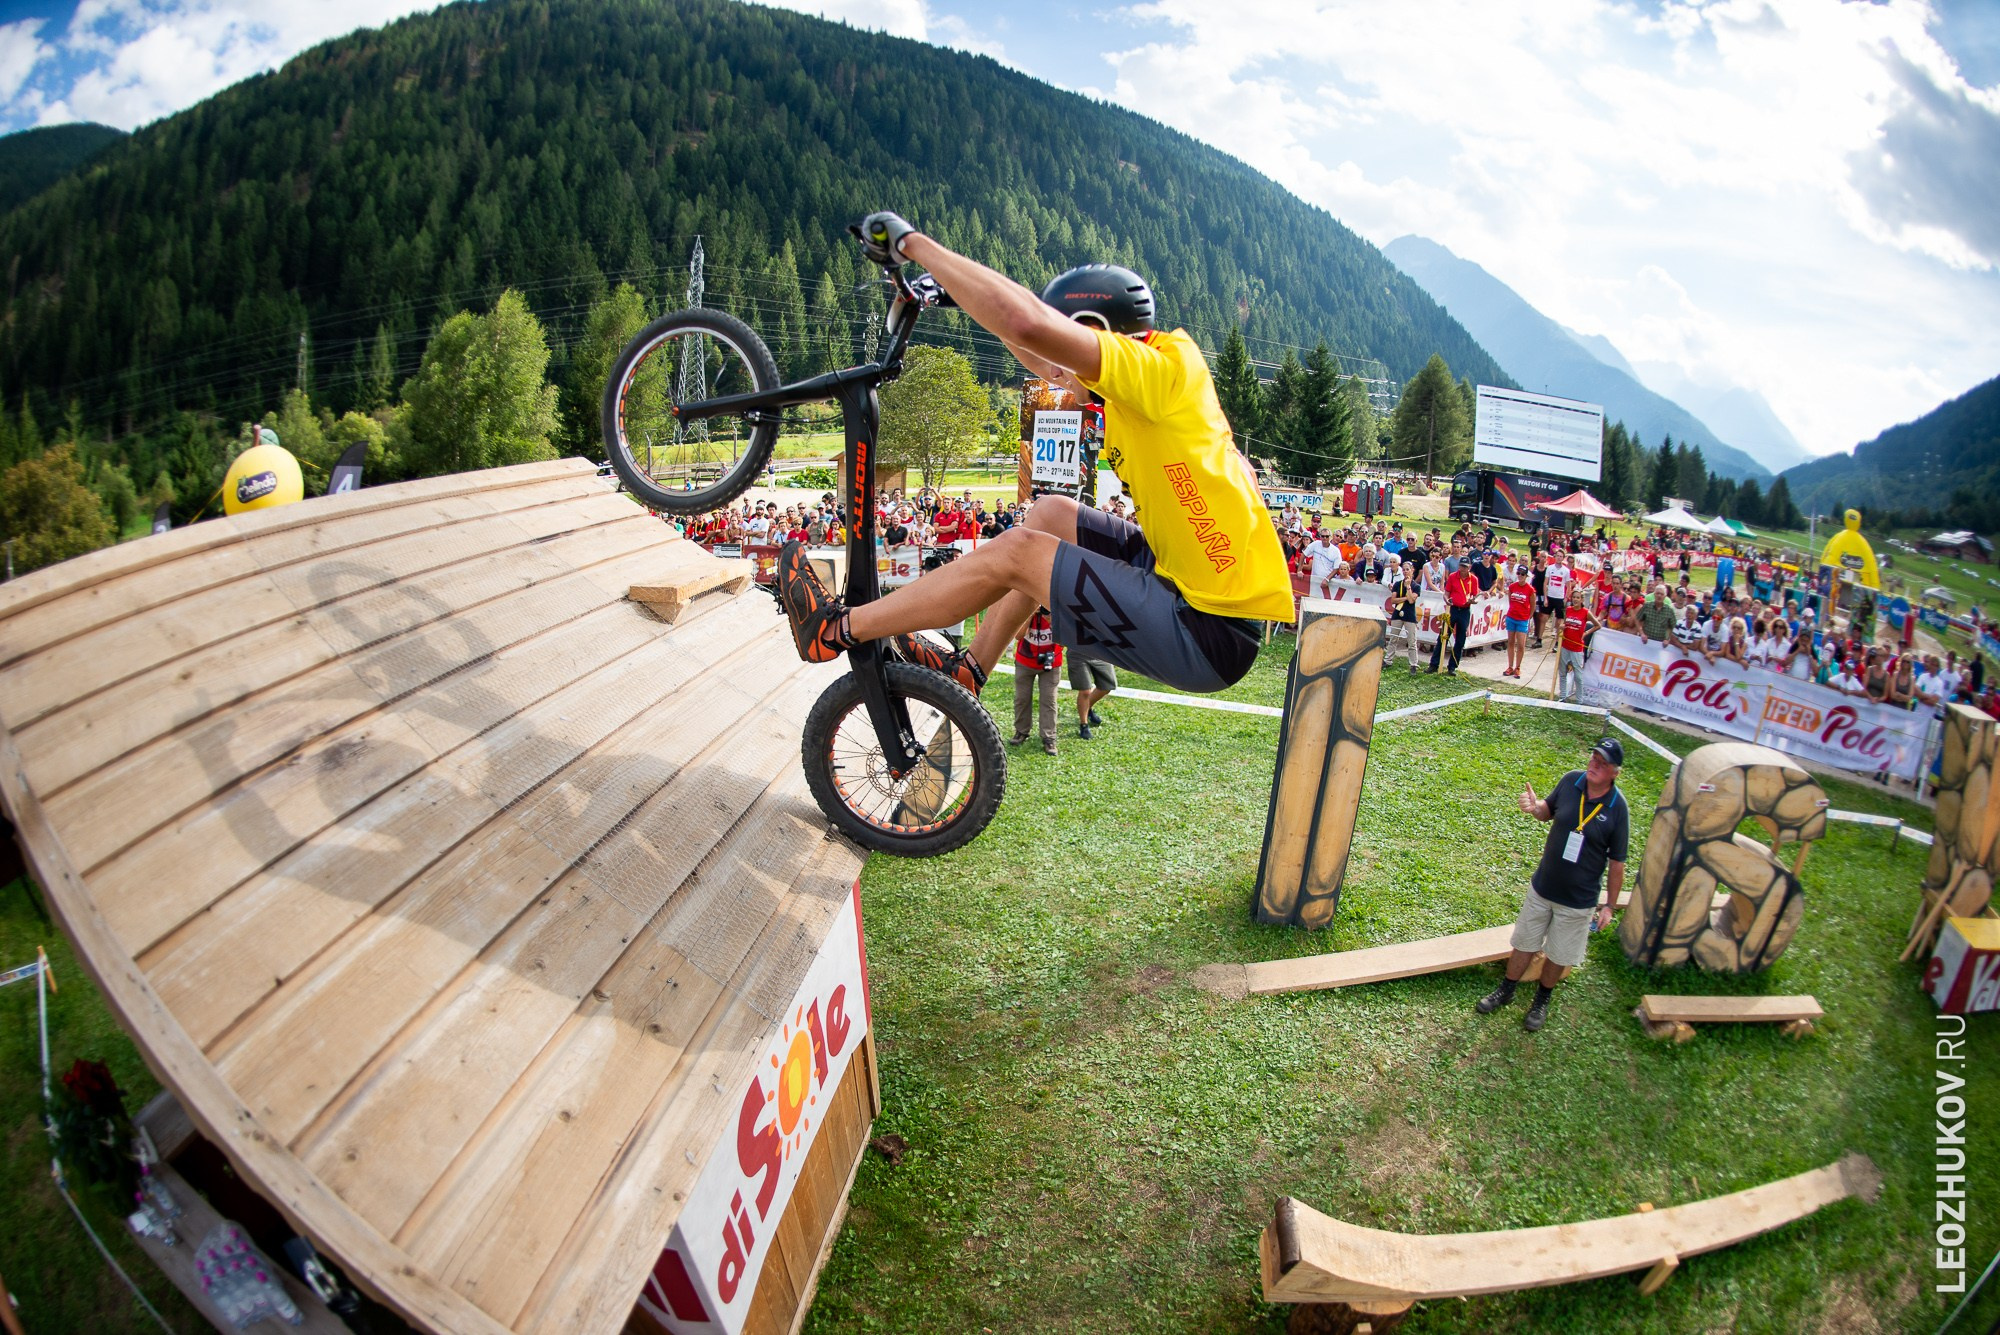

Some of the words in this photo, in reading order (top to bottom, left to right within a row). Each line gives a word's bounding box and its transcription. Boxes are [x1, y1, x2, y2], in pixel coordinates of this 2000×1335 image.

[1062, 468, 1076, 477] AUG.
[1517, 478, 1541, 488] WATCH
[1548, 483, 1559, 491] ON
[1163, 462, 1237, 574] ESPAÑA
[1603, 653, 1656, 687] IPER
[1766, 699, 1817, 730] IPER
